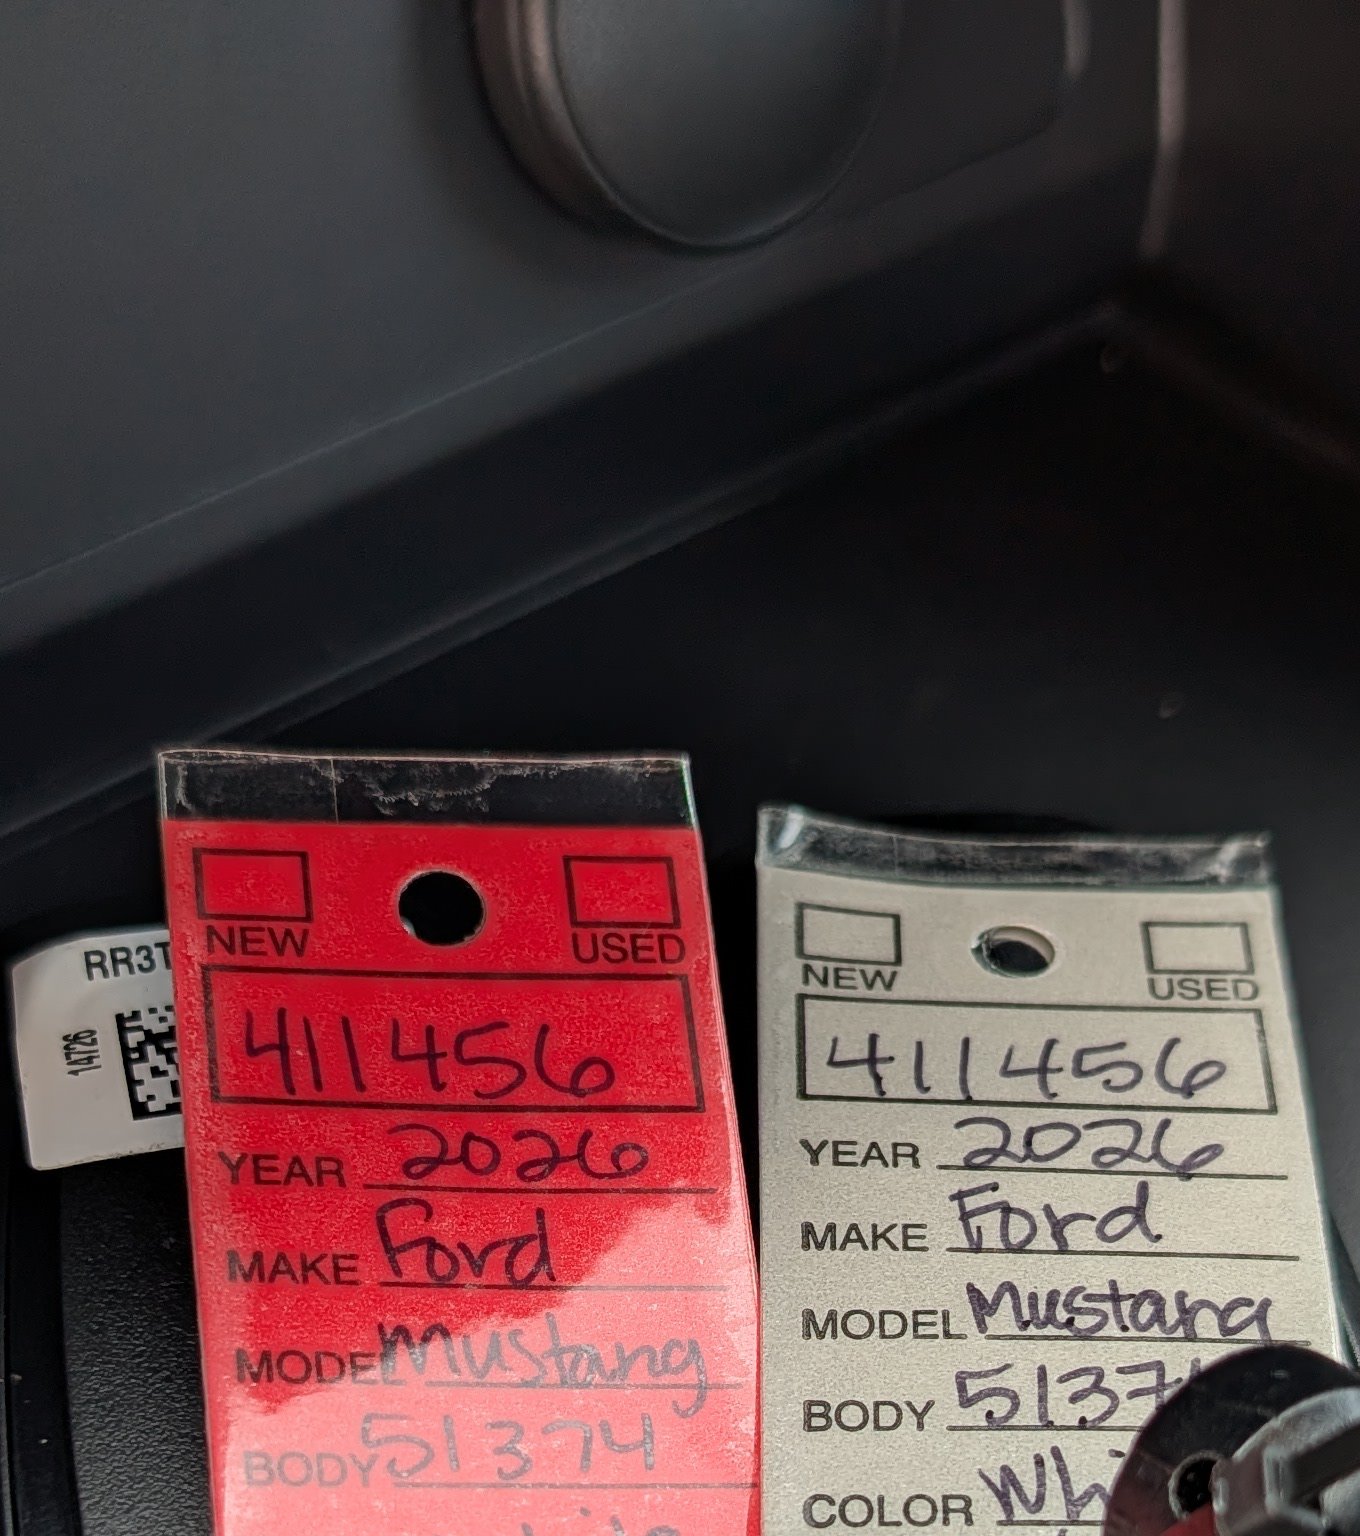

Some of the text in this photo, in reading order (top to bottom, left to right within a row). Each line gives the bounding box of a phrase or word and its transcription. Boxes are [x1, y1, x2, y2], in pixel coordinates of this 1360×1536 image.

[205, 926, 309, 958] NEW
[571, 932, 686, 964] USED
[802, 964, 898, 990] NEW
[1147, 978, 1260, 1001] USED
[245, 1007, 615, 1099] 411456
[827, 1033, 1227, 1100] 411456
[388, 1123, 648, 1182] 2026
[799, 1140, 921, 1169] YEAR
[953, 1116, 1224, 1181] 2026
[219, 1151, 346, 1187] YEAR
[948, 1181, 1163, 1253] Ford
[376, 1197, 556, 1287] Ford
[802, 1222, 929, 1252] MAKE
[227, 1250, 360, 1286] MAKE
[802, 1309, 967, 1340] MODEL
[954, 1357, 1201, 1429] 5137
[803, 1400, 935, 1432] BODY
[360, 1412, 655, 1480] 51374
[242, 1451, 378, 1486] BODY
[802, 1494, 973, 1528] COLOR
